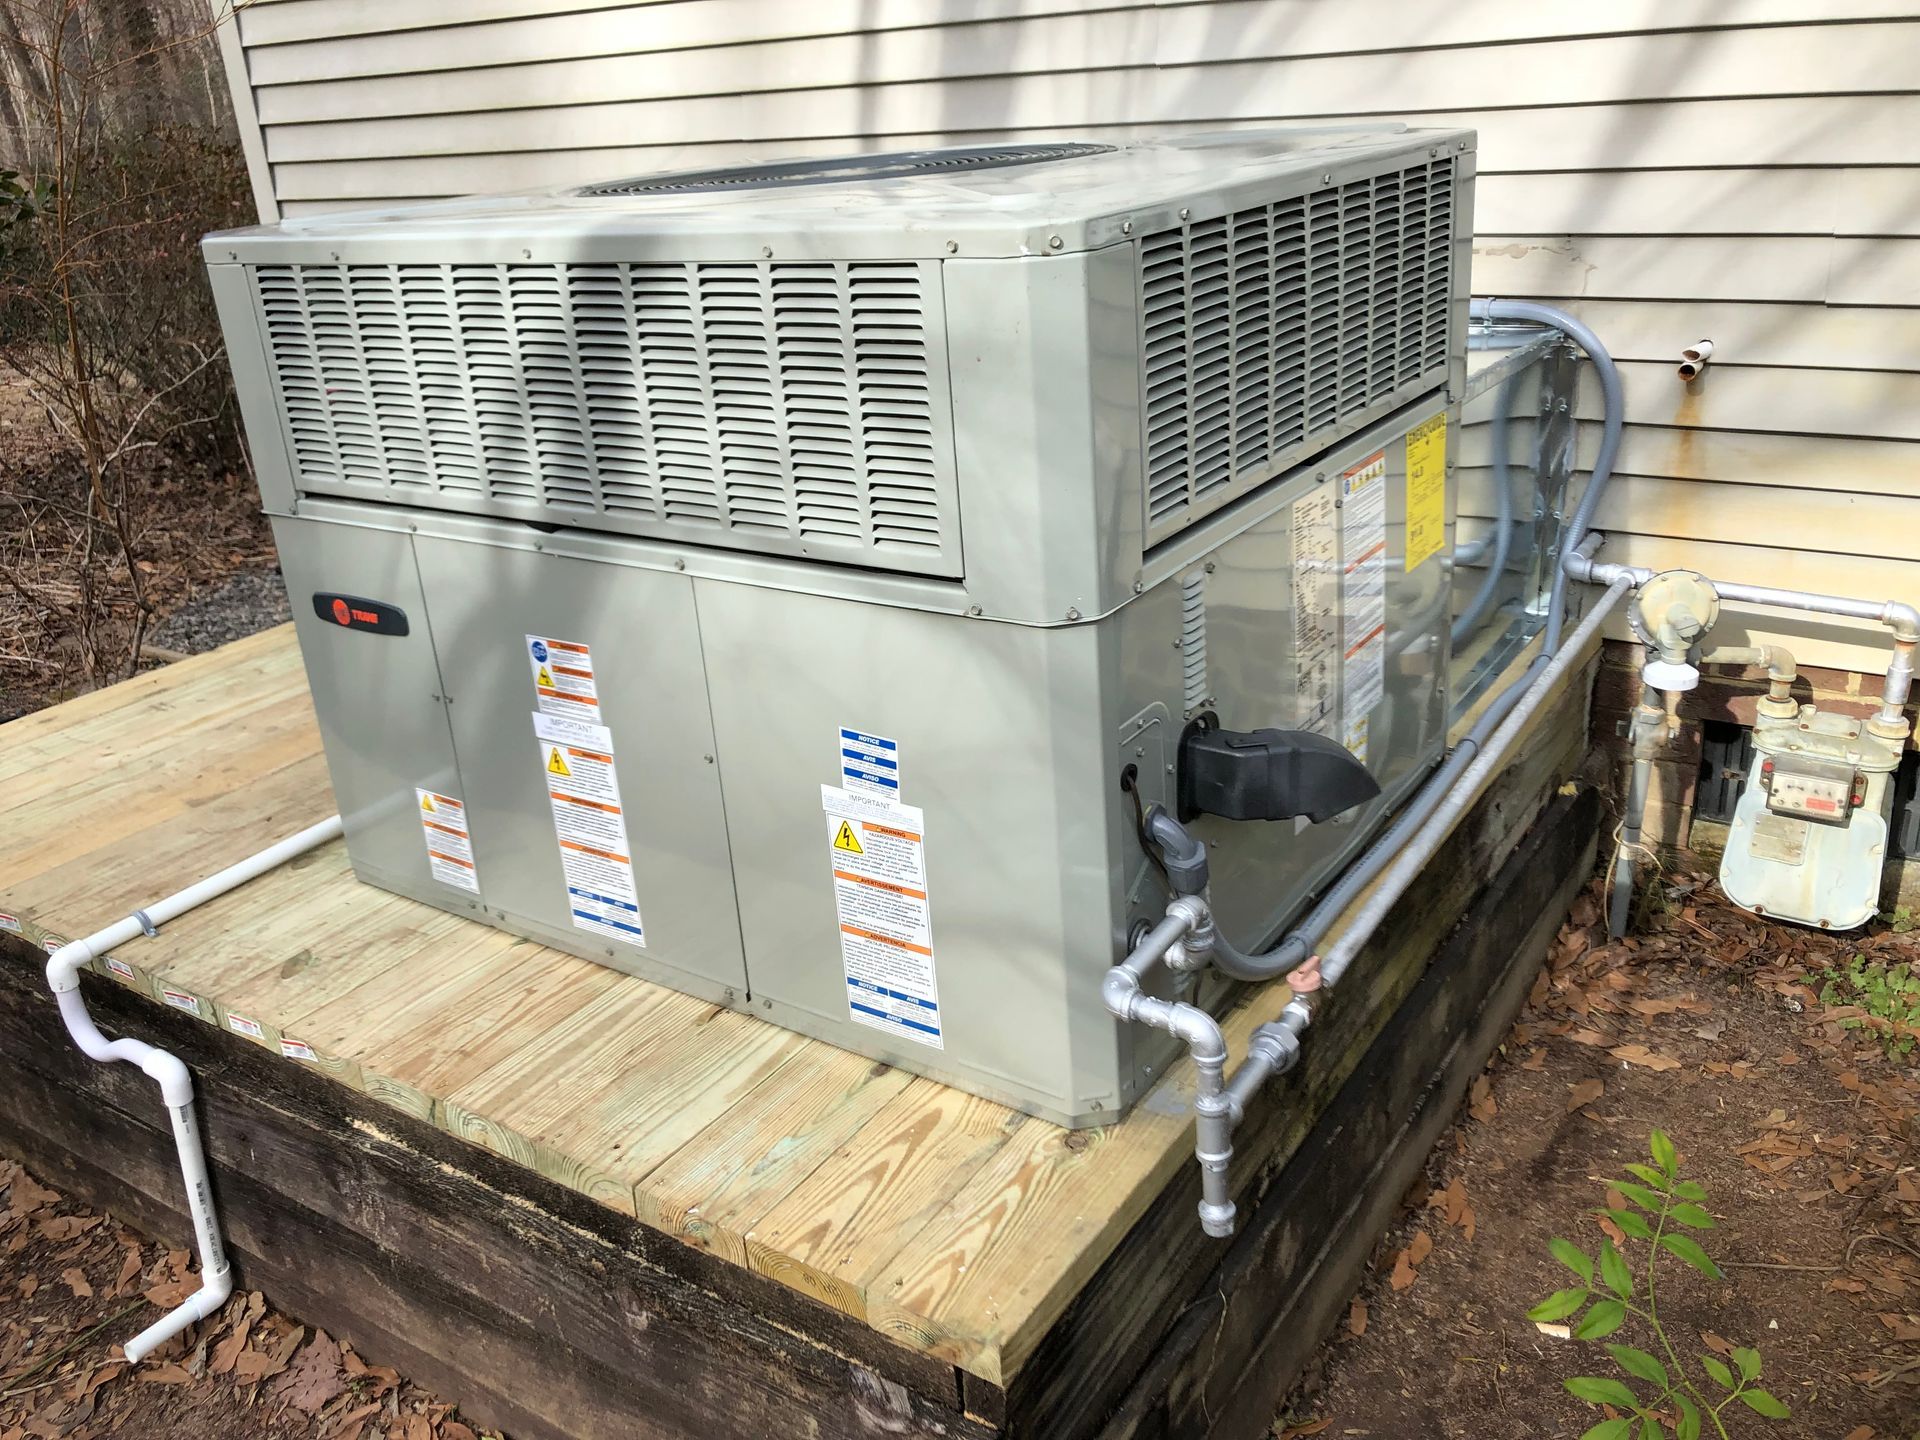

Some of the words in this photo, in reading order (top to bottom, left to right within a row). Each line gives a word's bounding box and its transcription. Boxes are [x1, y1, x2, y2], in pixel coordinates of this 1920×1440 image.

[858, 735, 880, 745] NOTICE
[863, 755, 876, 763] AVIS
[862, 773, 879, 782] AVISO
[849, 795, 890, 809] IMPORTANT
[881, 828, 905, 838] WARNING
[861, 878, 903, 893] AVERTISSEMENT
[870, 933, 906, 947] ADVERTENCIA
[858, 981, 878, 991] NOTICE
[906, 996, 920, 1004] AVIS
[886, 1013, 903, 1023] AVISO
